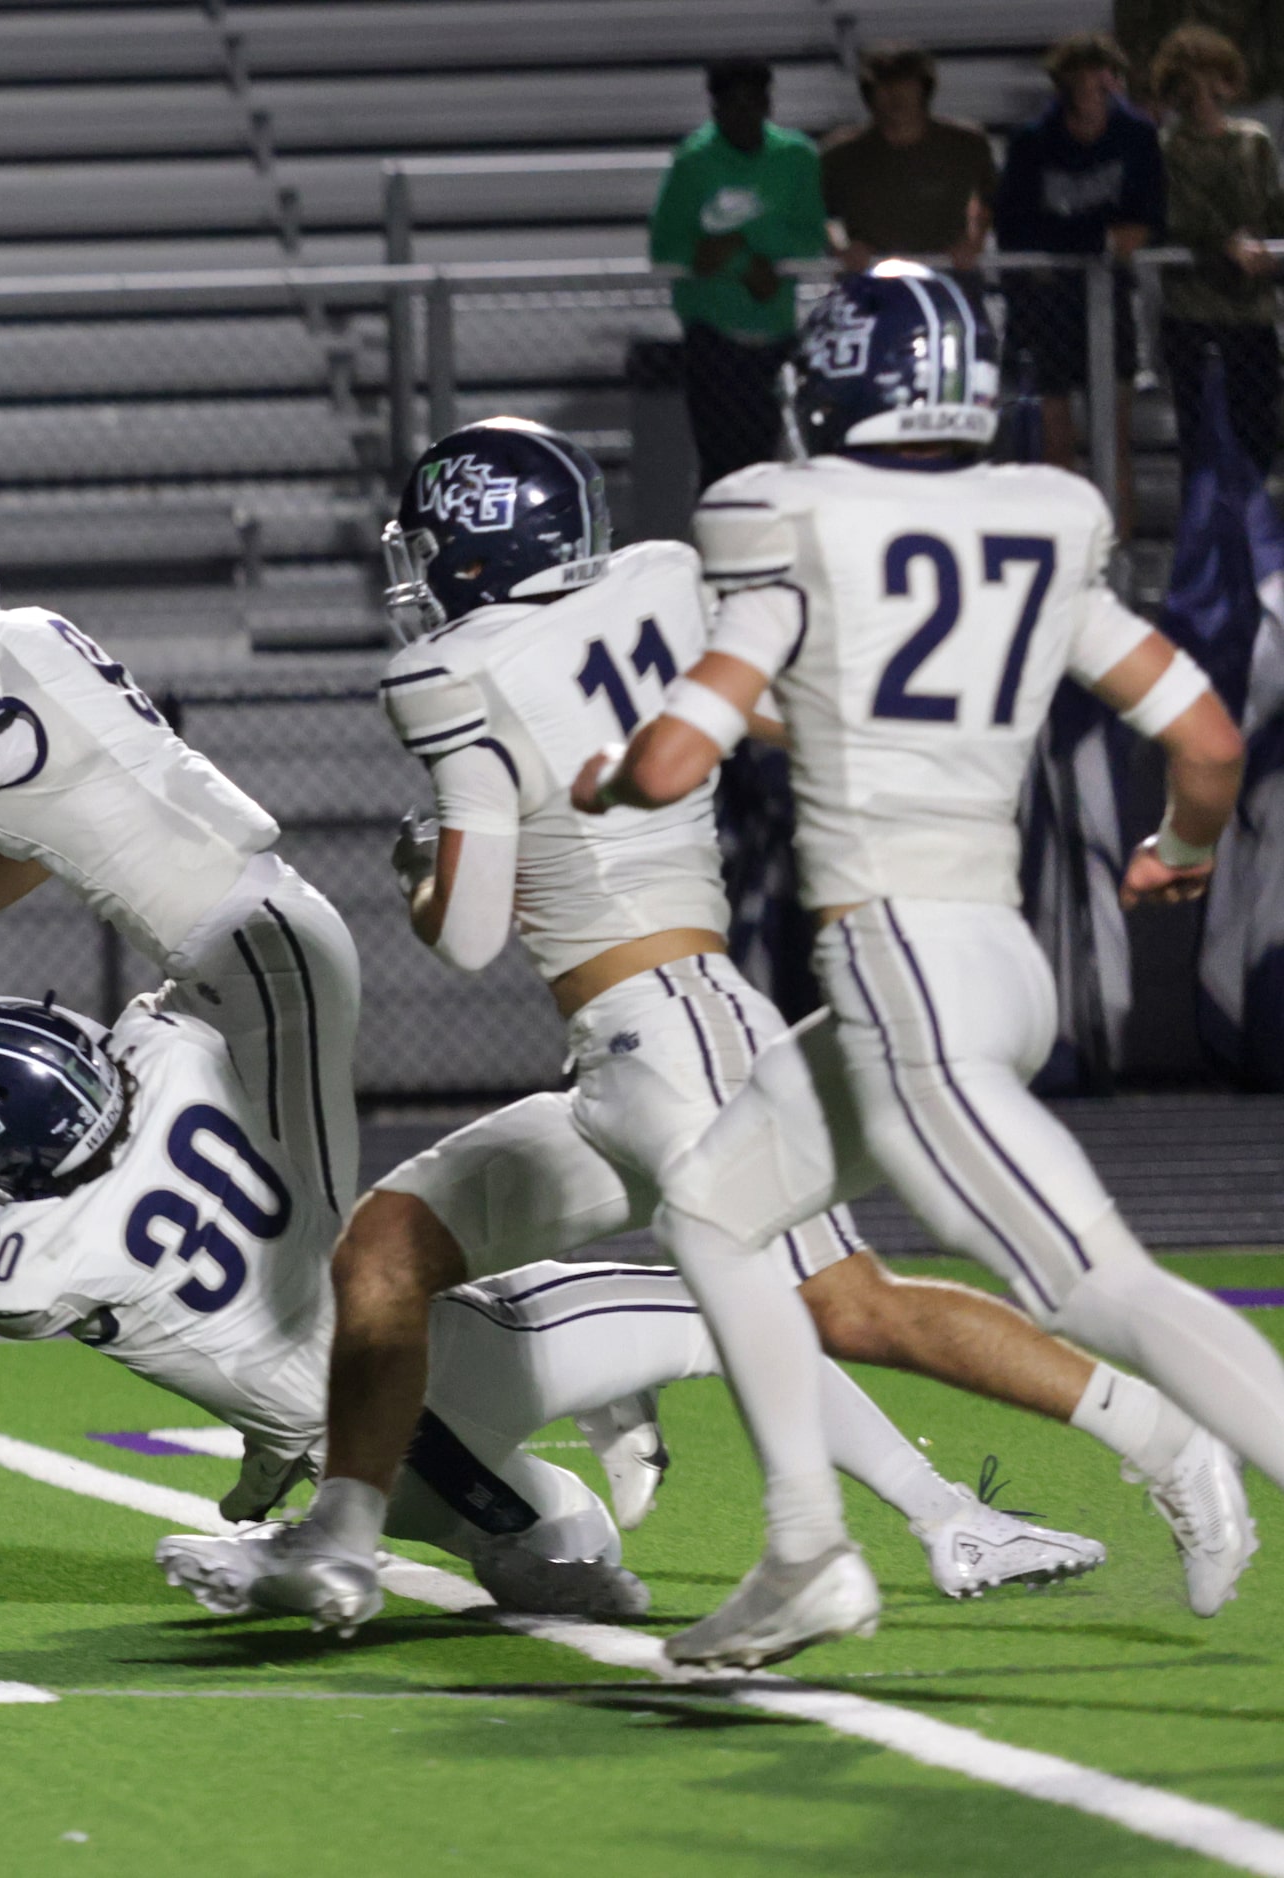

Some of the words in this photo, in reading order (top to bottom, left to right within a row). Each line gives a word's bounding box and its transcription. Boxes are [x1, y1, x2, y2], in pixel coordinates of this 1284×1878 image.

[563, 557, 609, 584] WILD
[871, 532, 1057, 727] 27
[573, 614, 679, 738] 11
[124, 1103, 293, 1314] 30
